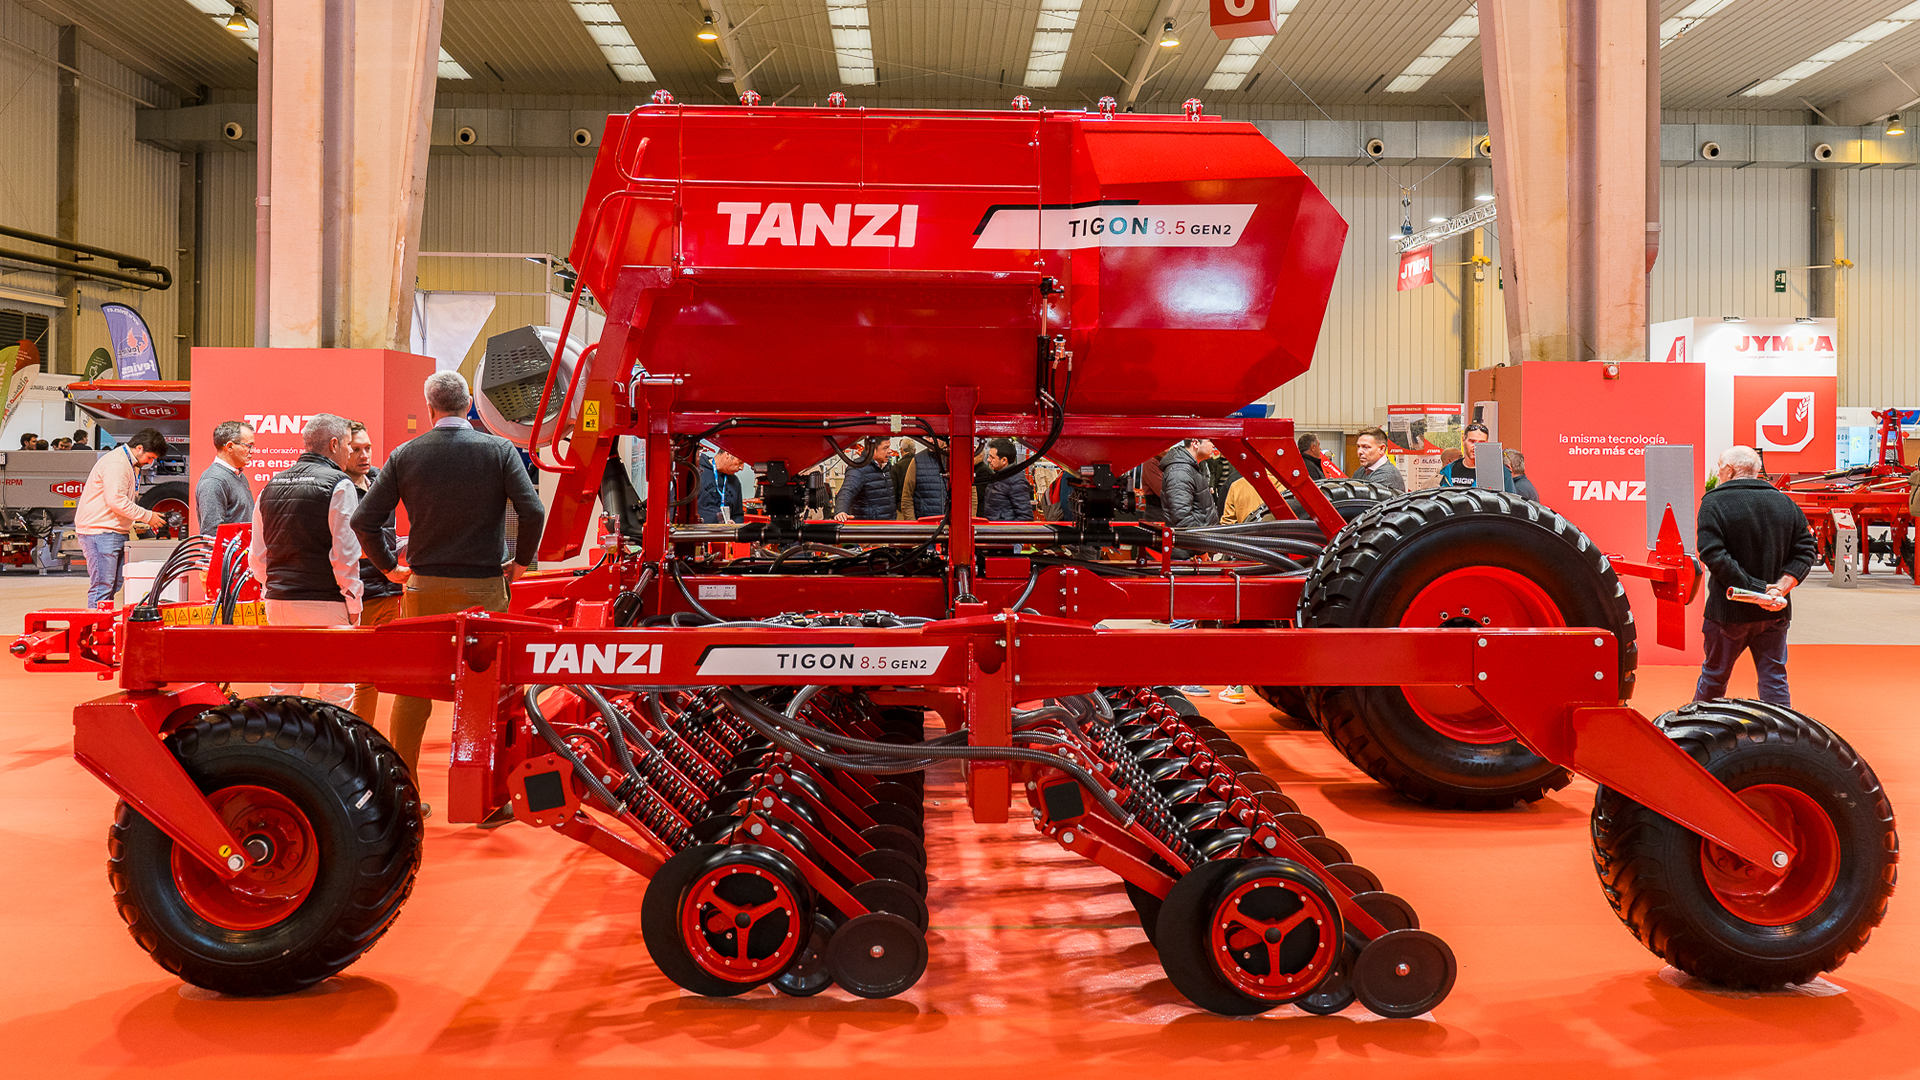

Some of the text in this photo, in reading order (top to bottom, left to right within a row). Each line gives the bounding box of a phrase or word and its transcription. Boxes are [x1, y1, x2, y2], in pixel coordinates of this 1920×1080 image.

[717, 202, 919, 247] TANZI
[1069, 217, 1232, 238] TIGON 8.5 GEN2
[1400, 256, 1430, 279] JYMPA
[1734, 335, 1834, 352] JYMPA
[139, 407, 171, 415] cleris
[1559, 434, 1668, 445] la misma tecnología,
[1568, 446, 1601, 455] ahora
[1602, 446, 1626, 455] más
[244, 459, 297, 468] ora ensa
[254, 473, 270, 481] en
[56, 483, 86, 493] cleri
[1568, 480, 1646, 501] TANZ
[525, 643, 663, 674] TANZI
[777, 653, 927, 669] TIGON 8.5 GEN2
